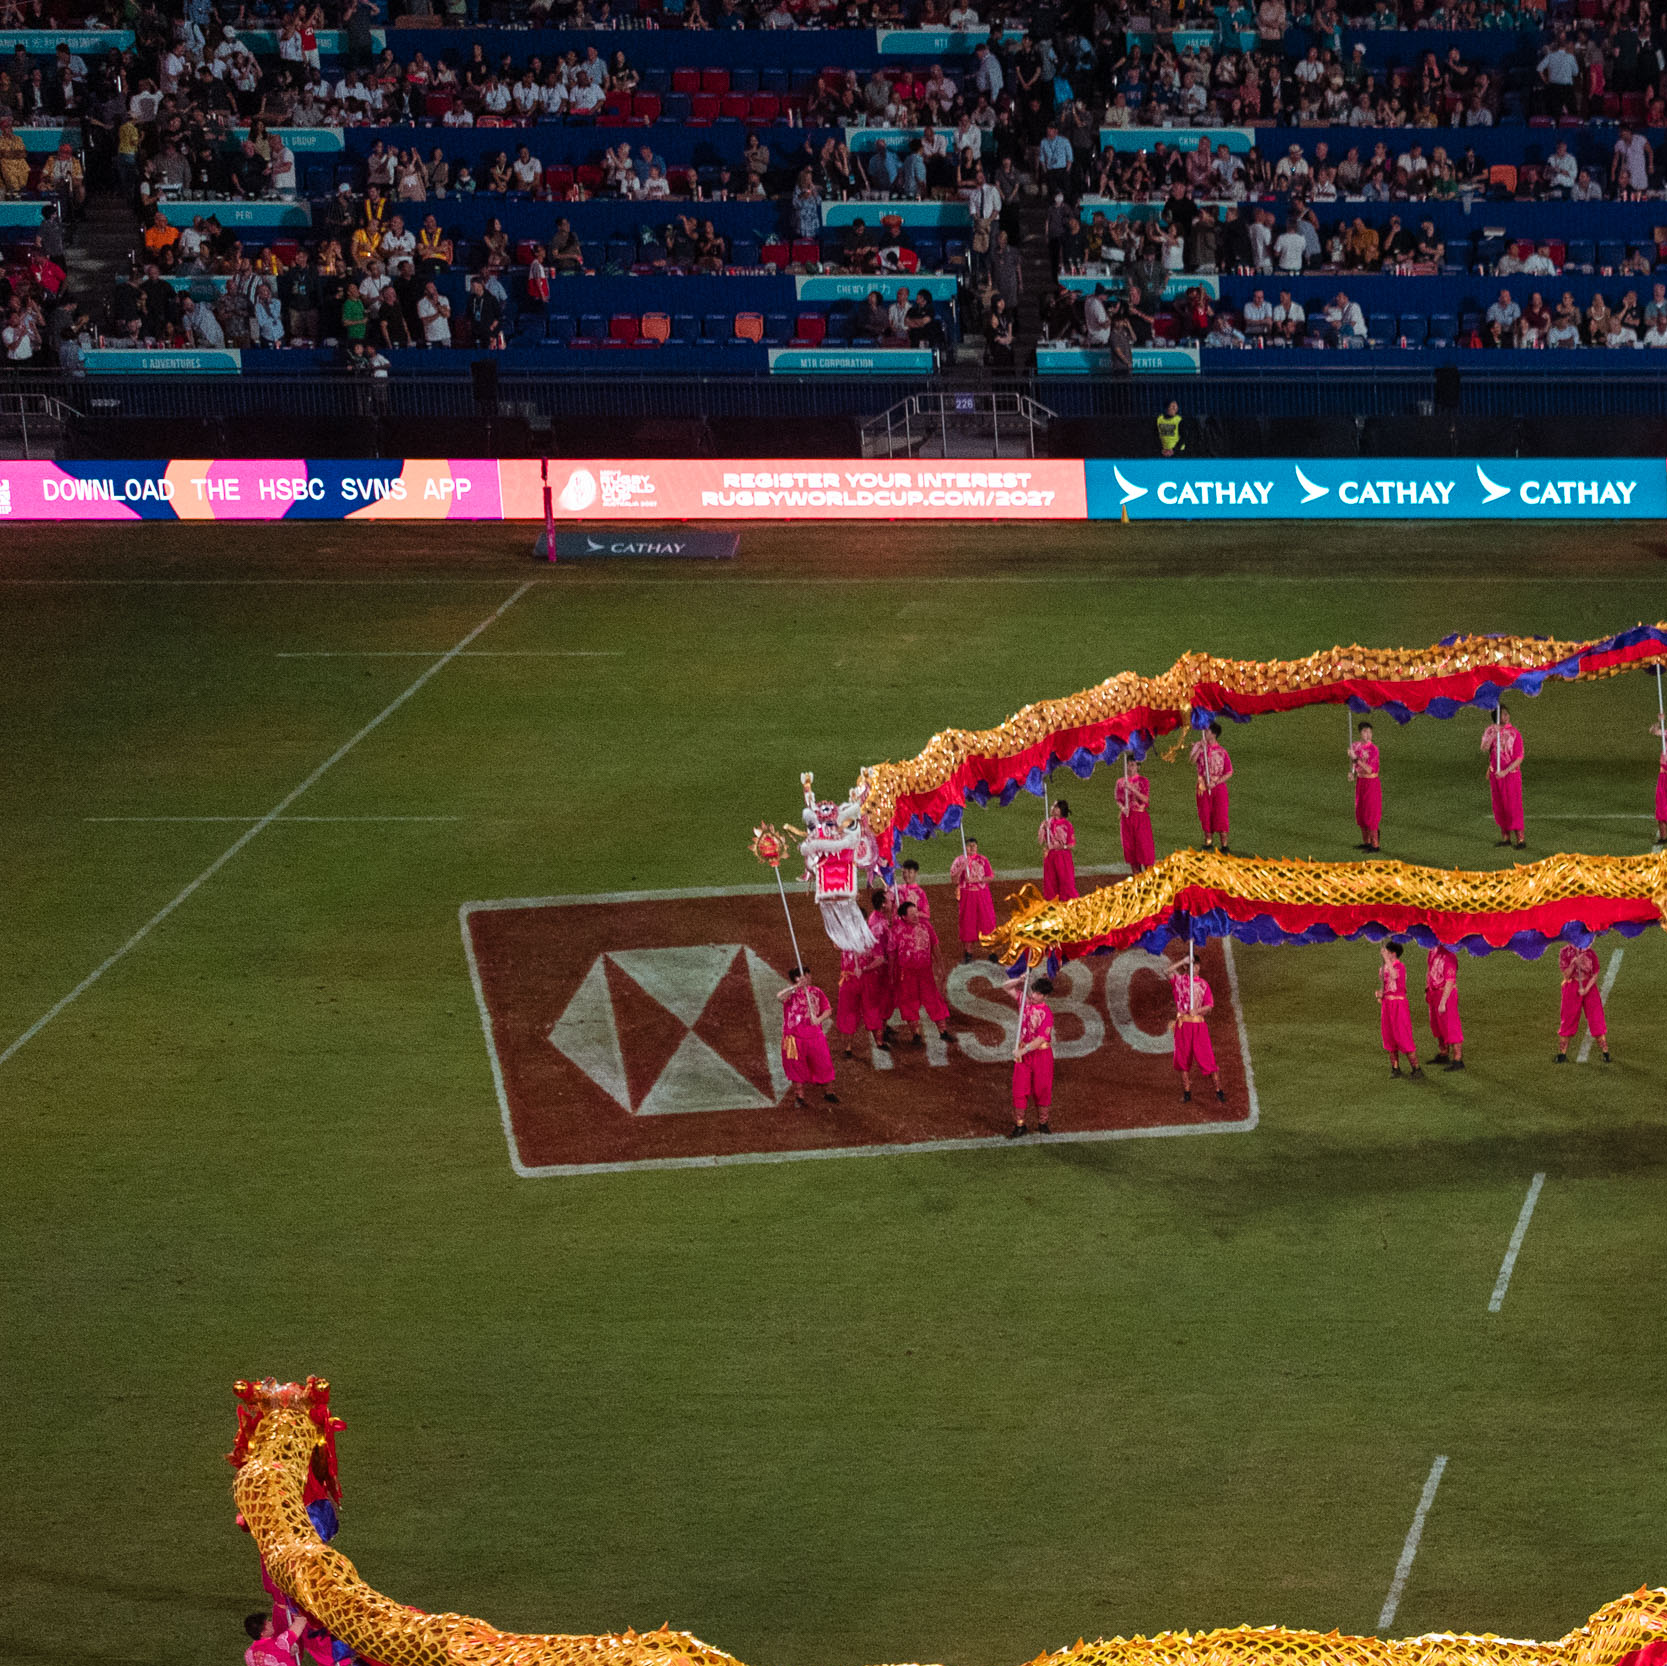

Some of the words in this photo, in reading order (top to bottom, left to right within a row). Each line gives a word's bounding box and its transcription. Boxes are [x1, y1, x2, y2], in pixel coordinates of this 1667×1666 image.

[150, 357, 201, 369] ADVENTURES
[801, 358, 816, 368] MTR
[820, 358, 874, 368] CORPORATION
[955, 398, 974, 410] 226
[43, 478, 175, 501] DOWNLOAD
[190, 478, 241, 501] THE
[259, 478, 325, 501] HSBC
[341, 478, 408, 501] SVNS
[423, 477, 472, 500] APP
[723, 472, 838, 489] REGISTER
[845, 472, 911, 489] YOUR
[917, 472, 1032, 489] INTEREST
[701, 490, 1056, 507] RUGBYWORLDCUP.COM/2027
[1157, 481, 1275, 504] CATHAY
[1338, 481, 1456, 504] CATHAY
[1519, 481, 1637, 504] CATHAY
[609, 542, 687, 554] CATHAY
